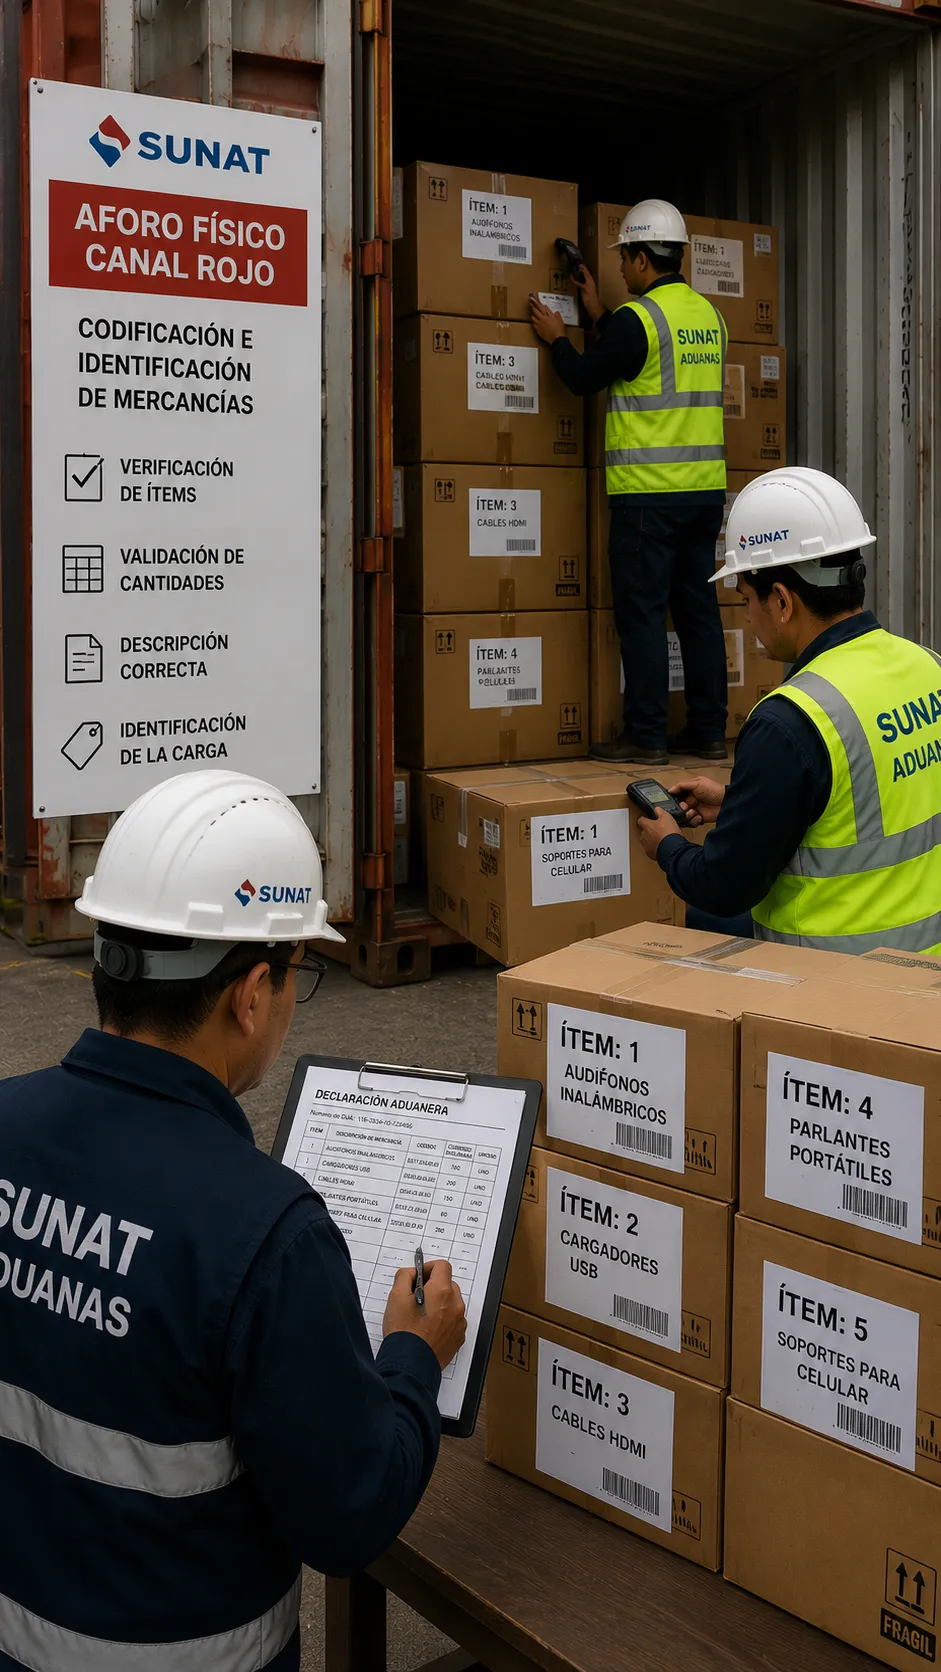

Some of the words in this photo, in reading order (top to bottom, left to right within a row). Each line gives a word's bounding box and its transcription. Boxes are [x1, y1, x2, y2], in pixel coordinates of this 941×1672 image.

[137, 131, 270, 175] SUNAT
[469, 197, 498, 214] ÍTEM:
[503, 205, 507, 215] 1
[74, 203, 183, 240] AFORO
[193, 211, 285, 250] FÍSICO
[85, 243, 188, 279] CANAL
[198, 254, 274, 286] ROJO
[78, 317, 234, 348] CODIFICACIÓN
[242, 329, 253, 349] E
[677, 329, 719, 345] SUNAT
[78, 352, 251, 382] IDENTIFICACIÓN
[475, 350, 505, 366] ÍTEM:
[508, 356, 515, 367] 3
[680, 352, 720, 365] ADUANAS
[78, 387, 106, 408] DE
[114, 388, 254, 415] MERCANCÍAS
[120, 457, 234, 477] VERIFICACIÓN
[120, 486, 142, 502] DE
[147, 482, 196, 502] ÍTEMS
[476, 496, 507, 511] ÍTEM:
[511, 500, 517, 511] 3
[477, 518, 507, 527] CABLES
[508, 519, 527, 527] HDMI
[748, 529, 789, 546] SUNAT
[120, 545, 219, 564] VALIDACIÓN
[224, 548, 244, 564] DE
[120, 575, 224, 591] CANTIDADES
[120, 631, 228, 652] DESCRIPCIÓN
[477, 646, 507, 660] ÍTEM:
[511, 648, 518, 659] 4
[120, 661, 207, 679] CORRECTA
[120, 712, 246, 738] IDENTIFICACIÓN
[877, 689, 941, 743] SUNA
[120, 749, 142, 765] DE
[147, 747, 168, 763] LA
[172, 743, 228, 762] CARGA
[541, 825, 585, 844] ÍTEM:
[590, 824, 597, 839] 1
[542, 849, 587, 863] SOPORTES
[589, 847, 612, 857] PARA
[550, 863, 592, 877] CELULAR
[259, 885, 312, 904] SUNAT
[561, 1020, 621, 1060] ÍTEM:
[629, 1041, 639, 1063] 1
[564, 1063, 649, 1097] AUDÍFONOS
[315, 1089, 389, 1108] DECLARACIÓN
[390, 1099, 448, 1116] ADUANERA
[561, 1086, 666, 1125] INALÁMBRICOS
[783, 1071, 850, 1115] ÍTEM:
[858, 1096, 874, 1120] 4
[790, 1117, 891, 1159] PARLANTES
[790, 1144, 892, 1187] PORTÁTILES
[560, 1185, 619, 1230] ÍTEM:
[626, 1213, 639, 1236] 2
[560, 1229, 659, 1276] CARGADORES
[570, 1257, 598, 1279] USB
[779, 1283, 845, 1335] ÍTEM:
[854, 1316, 868, 1342] 5
[777, 1331, 855, 1373] SOPORTES
[860, 1362, 901, 1391] PARA
[552, 1359, 610, 1409] ÍTEM:
[617, 1392, 630, 1416] 3
[797, 1364, 869, 1405] CELULAR
[551, 1405, 605, 1440] CABLES
[610, 1430, 646, 1459] HDMI
[883, 1614, 933, 1657] FRAGIL
